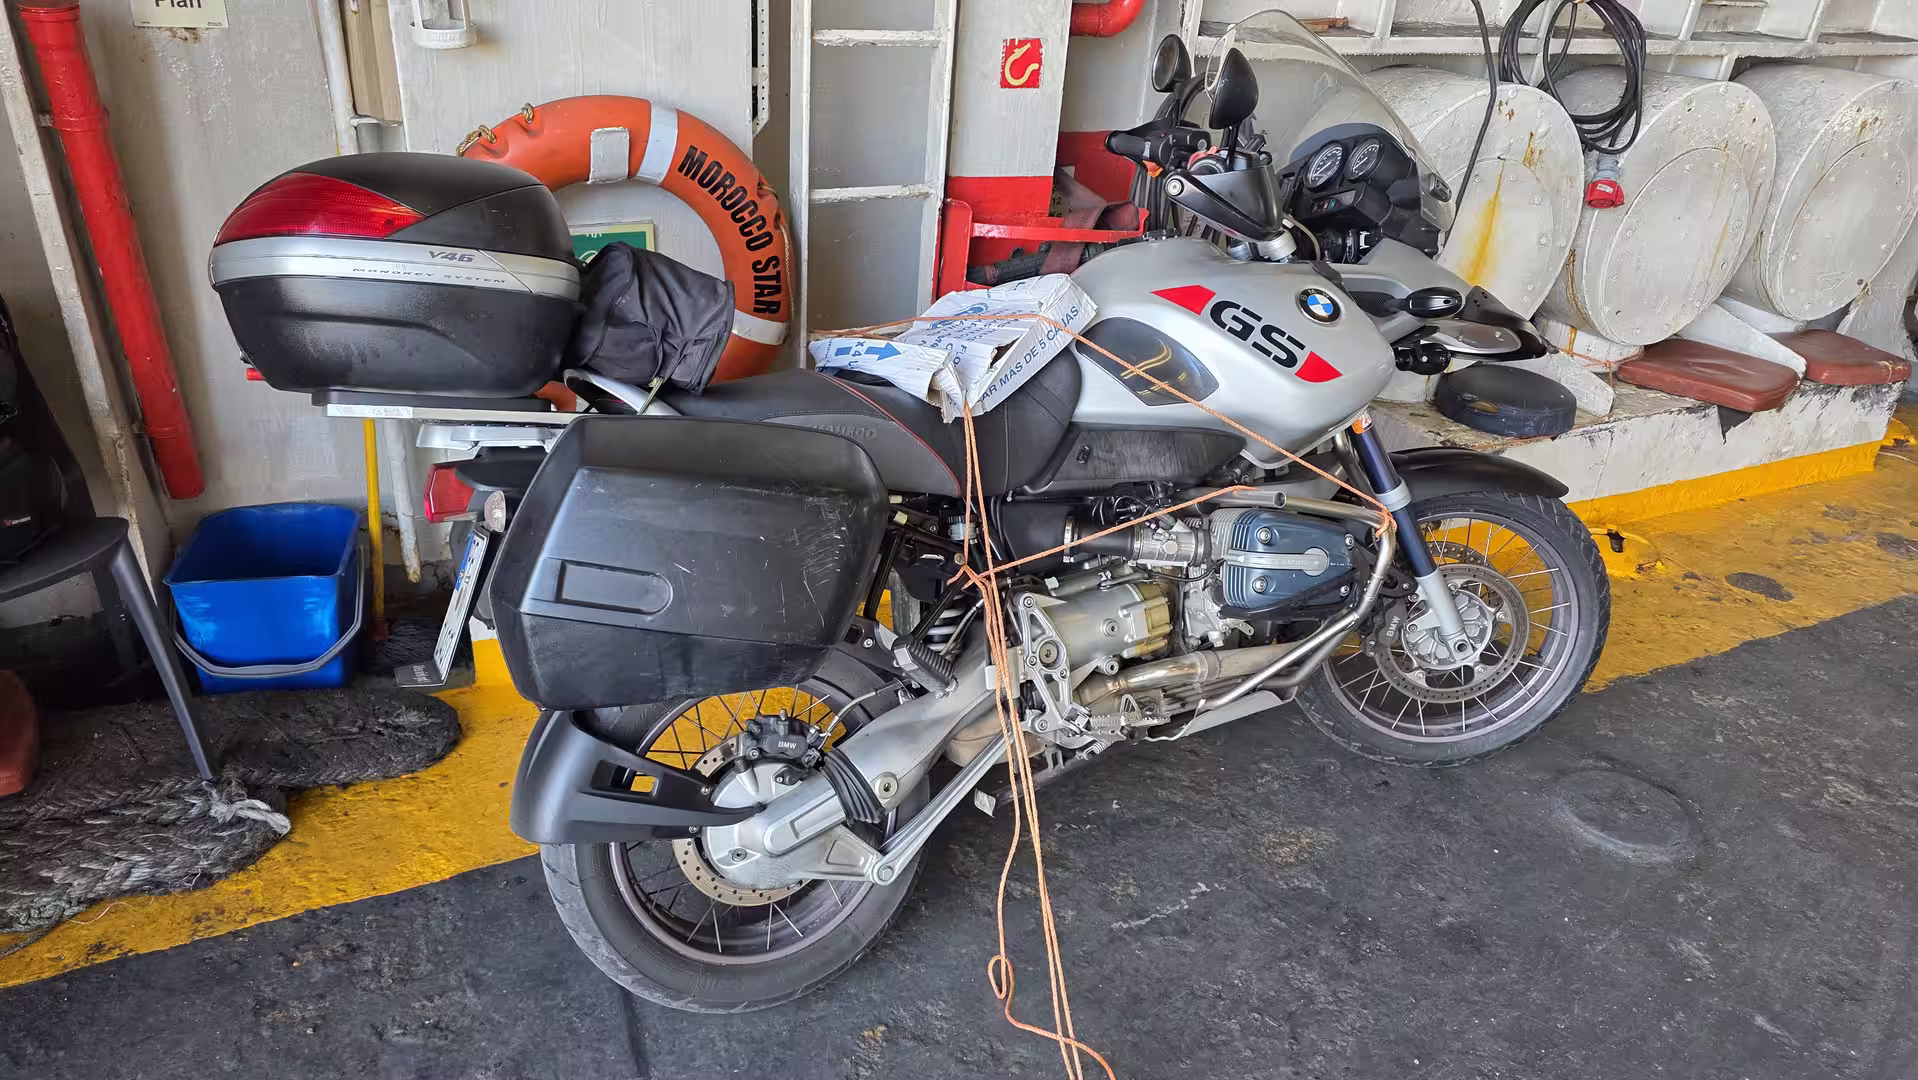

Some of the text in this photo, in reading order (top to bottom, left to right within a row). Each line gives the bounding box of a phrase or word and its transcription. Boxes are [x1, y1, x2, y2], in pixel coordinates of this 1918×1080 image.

[677, 144, 782, 315] MOROCCO STAR
[428, 250, 475, 263] V46
[352, 267, 506, 283] MONOKEY SYSTEM
[1300, 288, 1331, 301] BMW
[1209, 300, 1306, 369] GS
[1023, 346, 1040, 365] DE
[1038, 339, 1048, 352] 5
[1386, 615, 1400, 637] BMW
[777, 740, 797, 749] BMW
